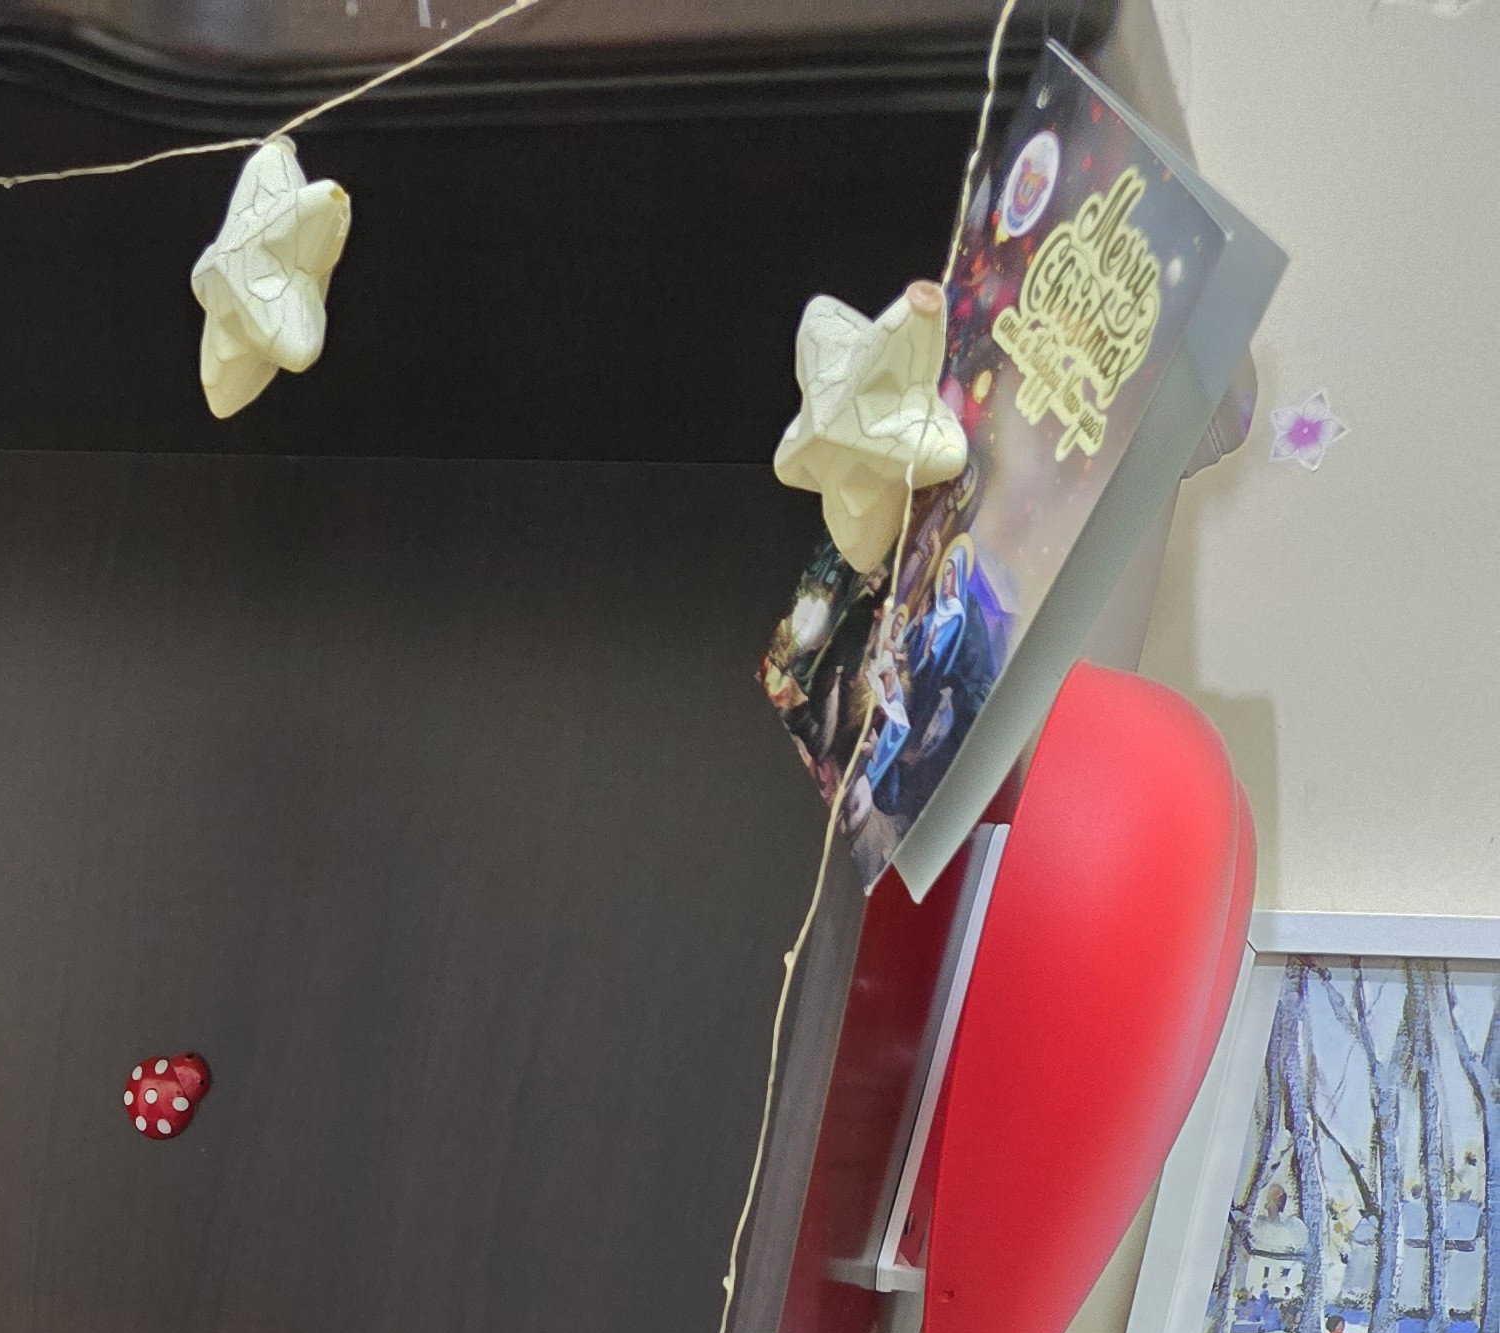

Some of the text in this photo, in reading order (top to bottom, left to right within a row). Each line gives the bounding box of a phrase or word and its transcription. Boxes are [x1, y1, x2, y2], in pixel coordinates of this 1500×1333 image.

[1027, 231, 1156, 398] Christmas
[1077, 175, 1157, 326] Merry
[1000, 316, 1029, 342] and
[1058, 409, 1103, 455] year
